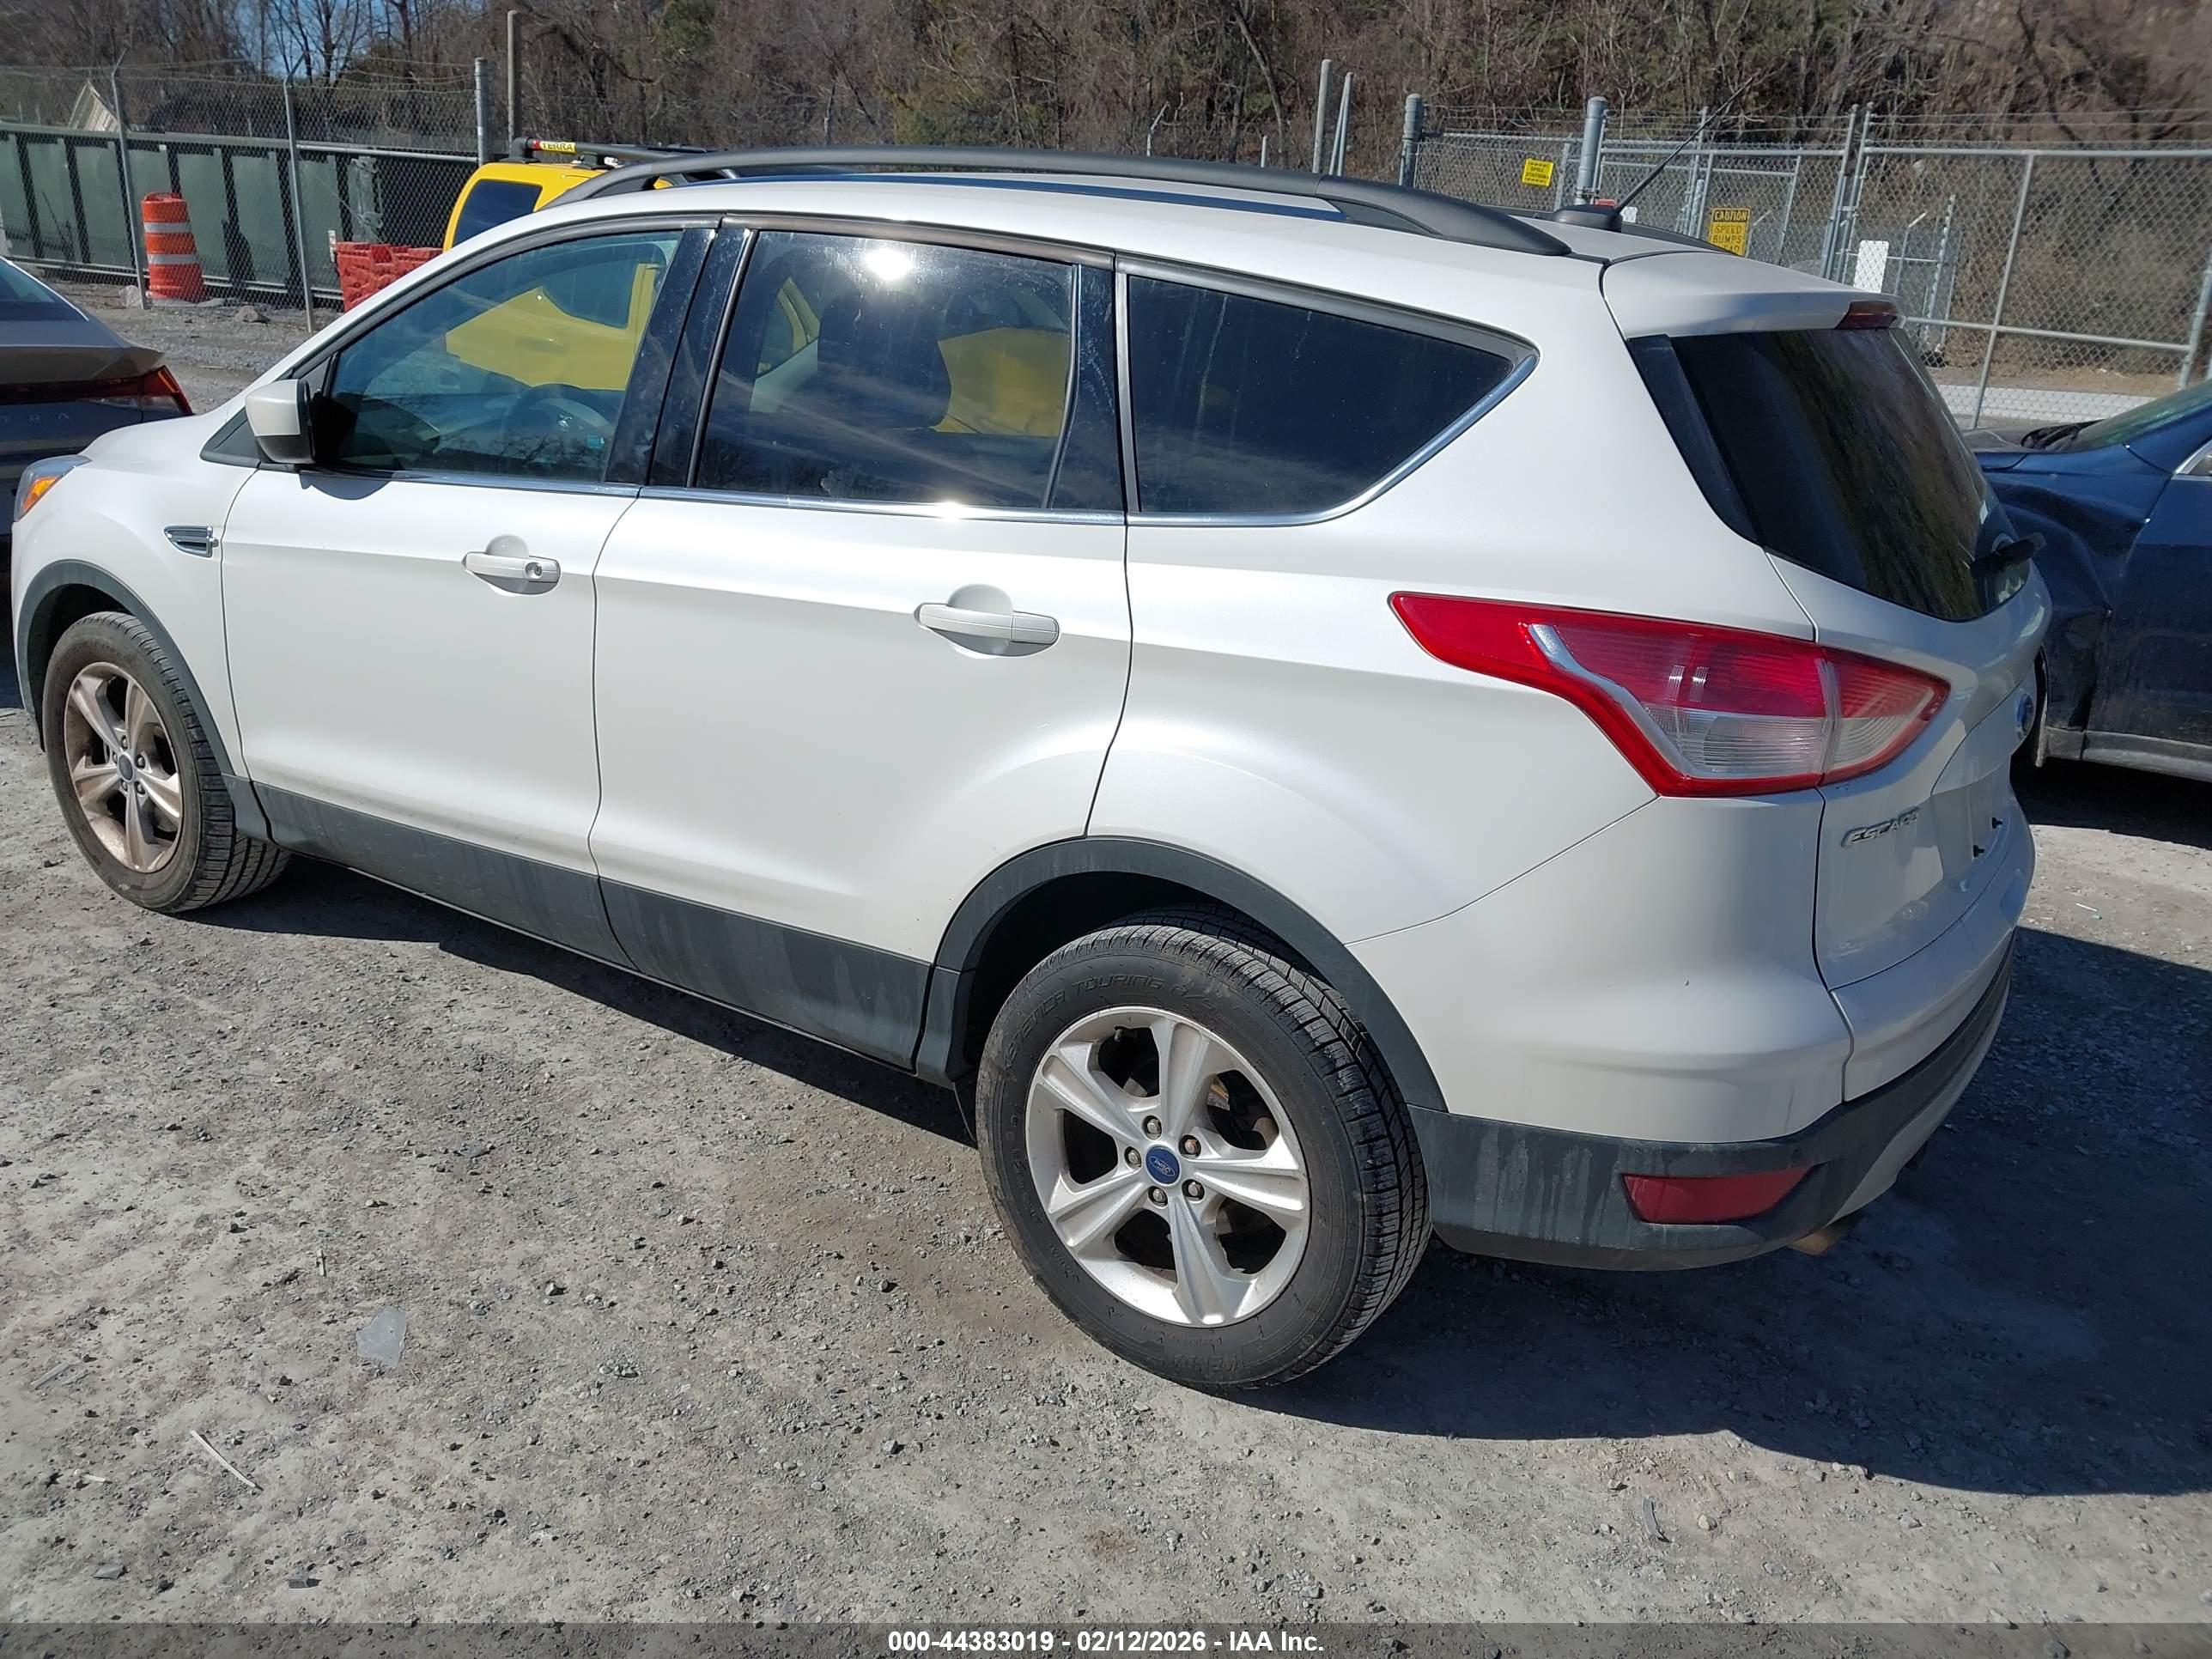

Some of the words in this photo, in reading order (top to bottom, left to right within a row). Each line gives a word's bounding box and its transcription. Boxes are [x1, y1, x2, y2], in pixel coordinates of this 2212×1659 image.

[1714, 210, 1747, 221] CAUTION
[1715, 225, 1742, 234] SPEED
[1712, 234, 1742, 243] BUMPS
[1072, 974, 1165, 995] TOURING
